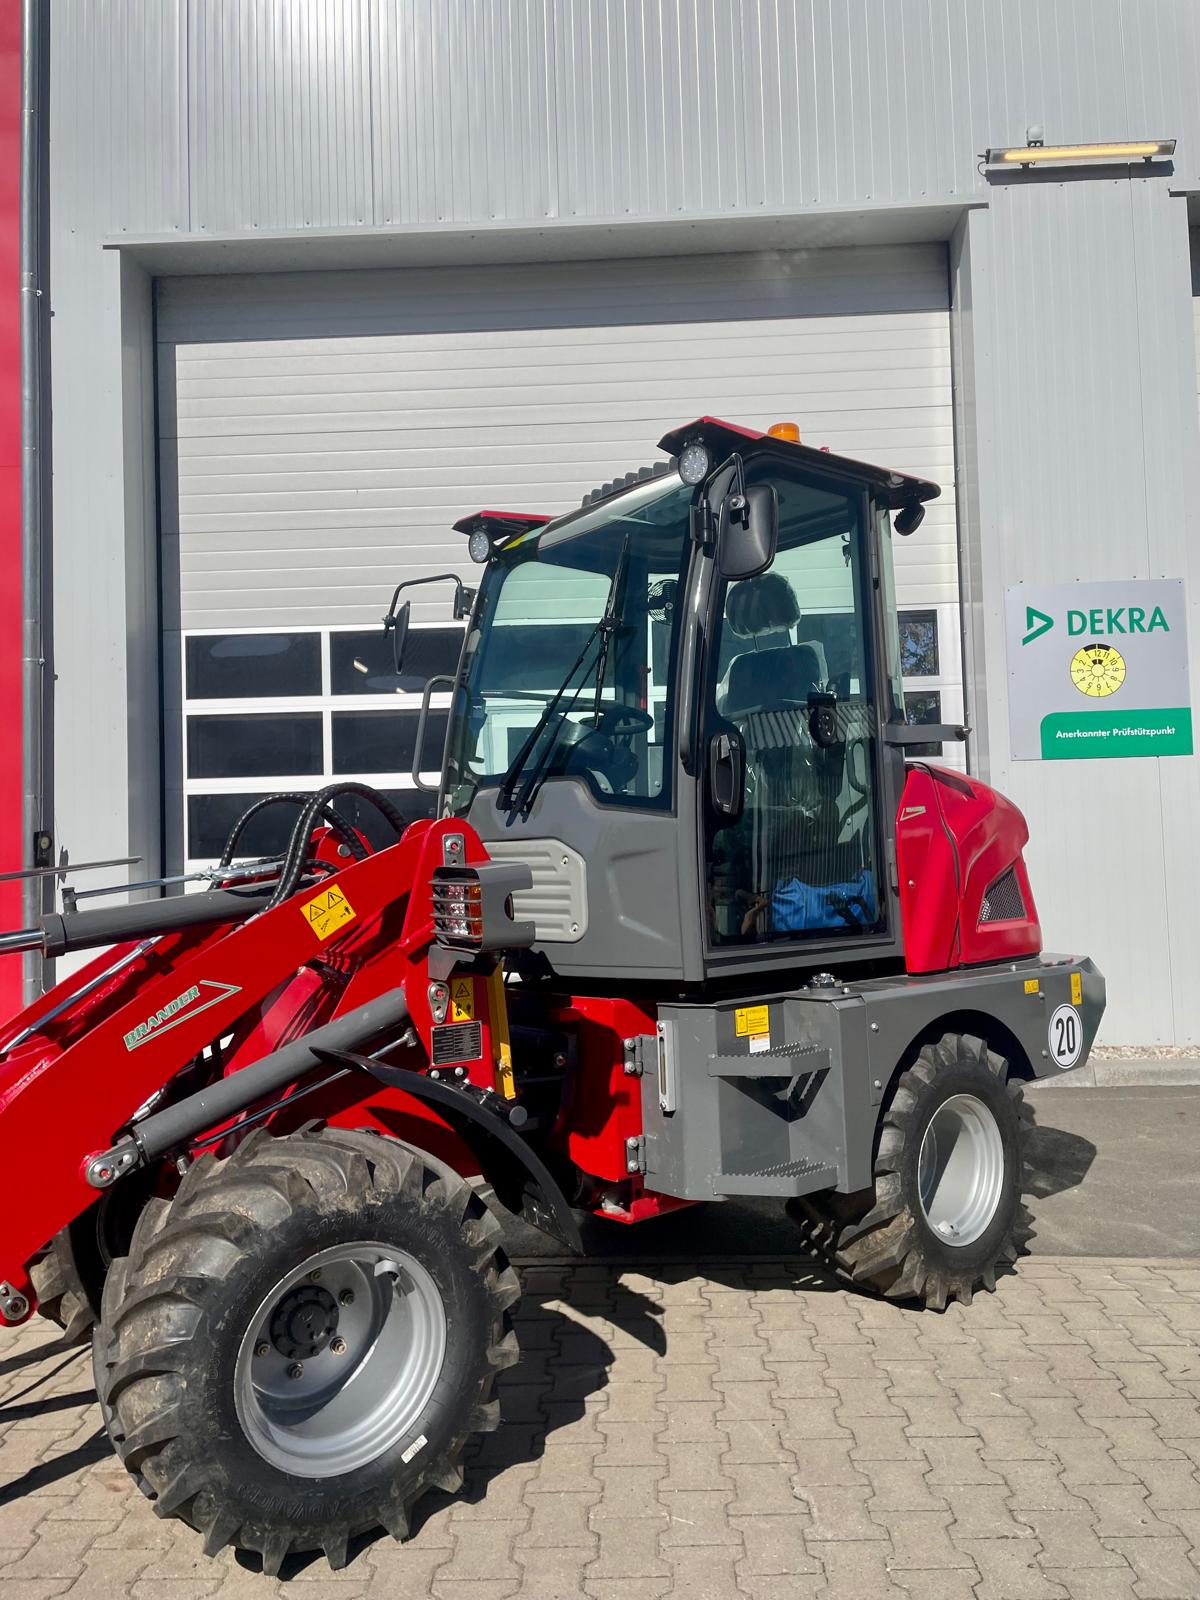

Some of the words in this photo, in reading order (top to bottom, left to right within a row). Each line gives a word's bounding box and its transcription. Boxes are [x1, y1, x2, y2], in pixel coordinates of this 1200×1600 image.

[1067, 606, 1170, 636] DEKRA
[1109, 657, 1118, 666] 10
[1055, 729, 1111, 739] Anerkannter
[1113, 727, 1176, 738] Prüfstützpunkt
[123, 985, 201, 1046] BRANDER
[1056, 1016, 1076, 1057] 20
